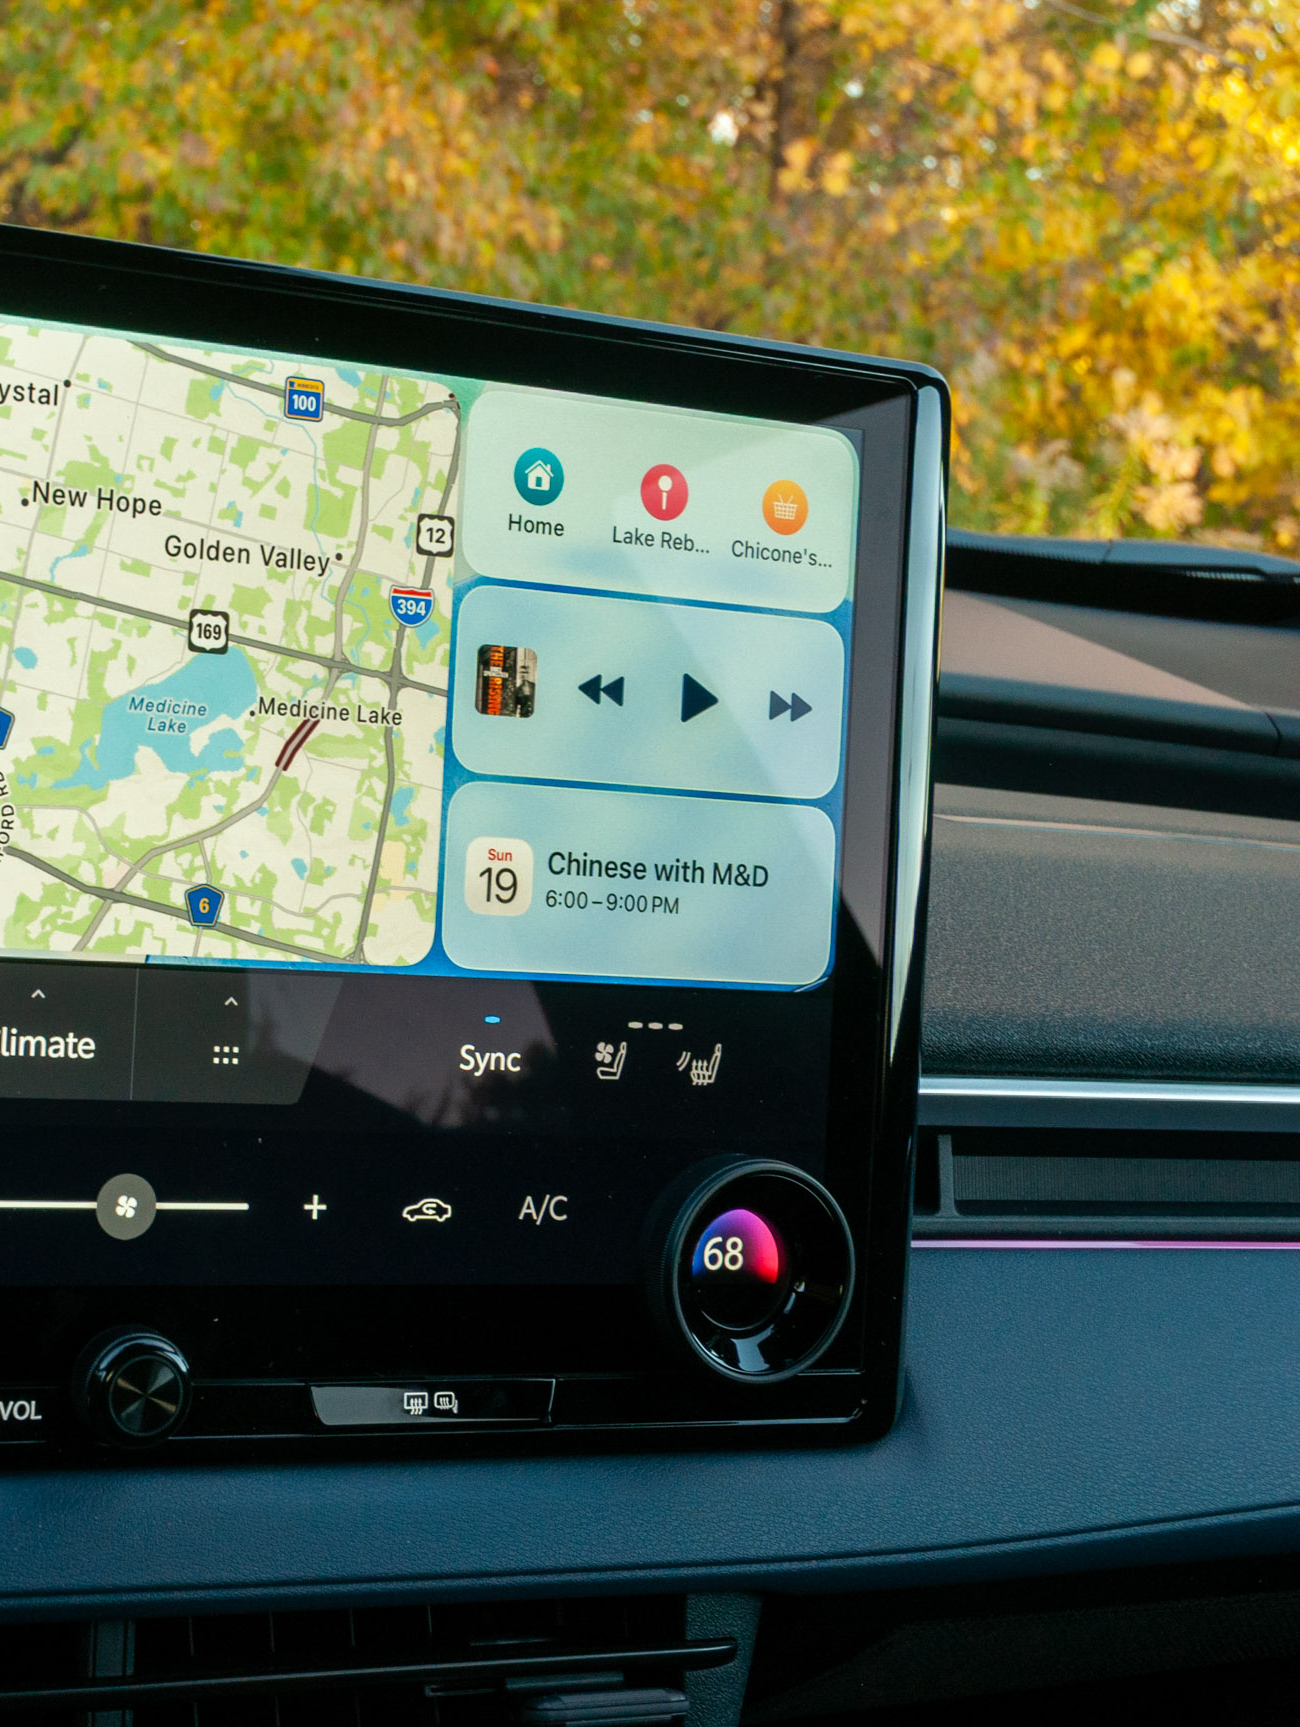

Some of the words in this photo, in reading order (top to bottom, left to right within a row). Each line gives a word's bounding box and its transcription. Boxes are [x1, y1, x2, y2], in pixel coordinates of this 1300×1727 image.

[292, 394, 317, 412] 100
[33, 481, 87, 507] New
[97, 487, 163, 518] Hope
[426, 527, 446, 545] 12
[508, 513, 565, 537] Home
[612, 525, 655, 547] Lake
[164, 534, 251, 565] Golden
[260, 544, 331, 576] Valley
[397, 599, 427, 617] 394
[196, 622, 222, 640] 169
[128, 696, 207, 717] Medicine
[258, 696, 350, 722] Medicine
[357, 704, 402, 726] Lake
[148, 717, 187, 734] Lake
[488, 849, 513, 862] Sun
[548, 851, 647, 880] Chinese
[654, 858, 705, 884] with
[712, 863, 769, 887] M&D
[479, 867, 518, 903] 19
[199, 897, 210, 914] 6
[459, 1044, 521, 1076] Sync
[518, 1194, 568, 1226] A/C
[703, 1236, 744, 1271] 68
